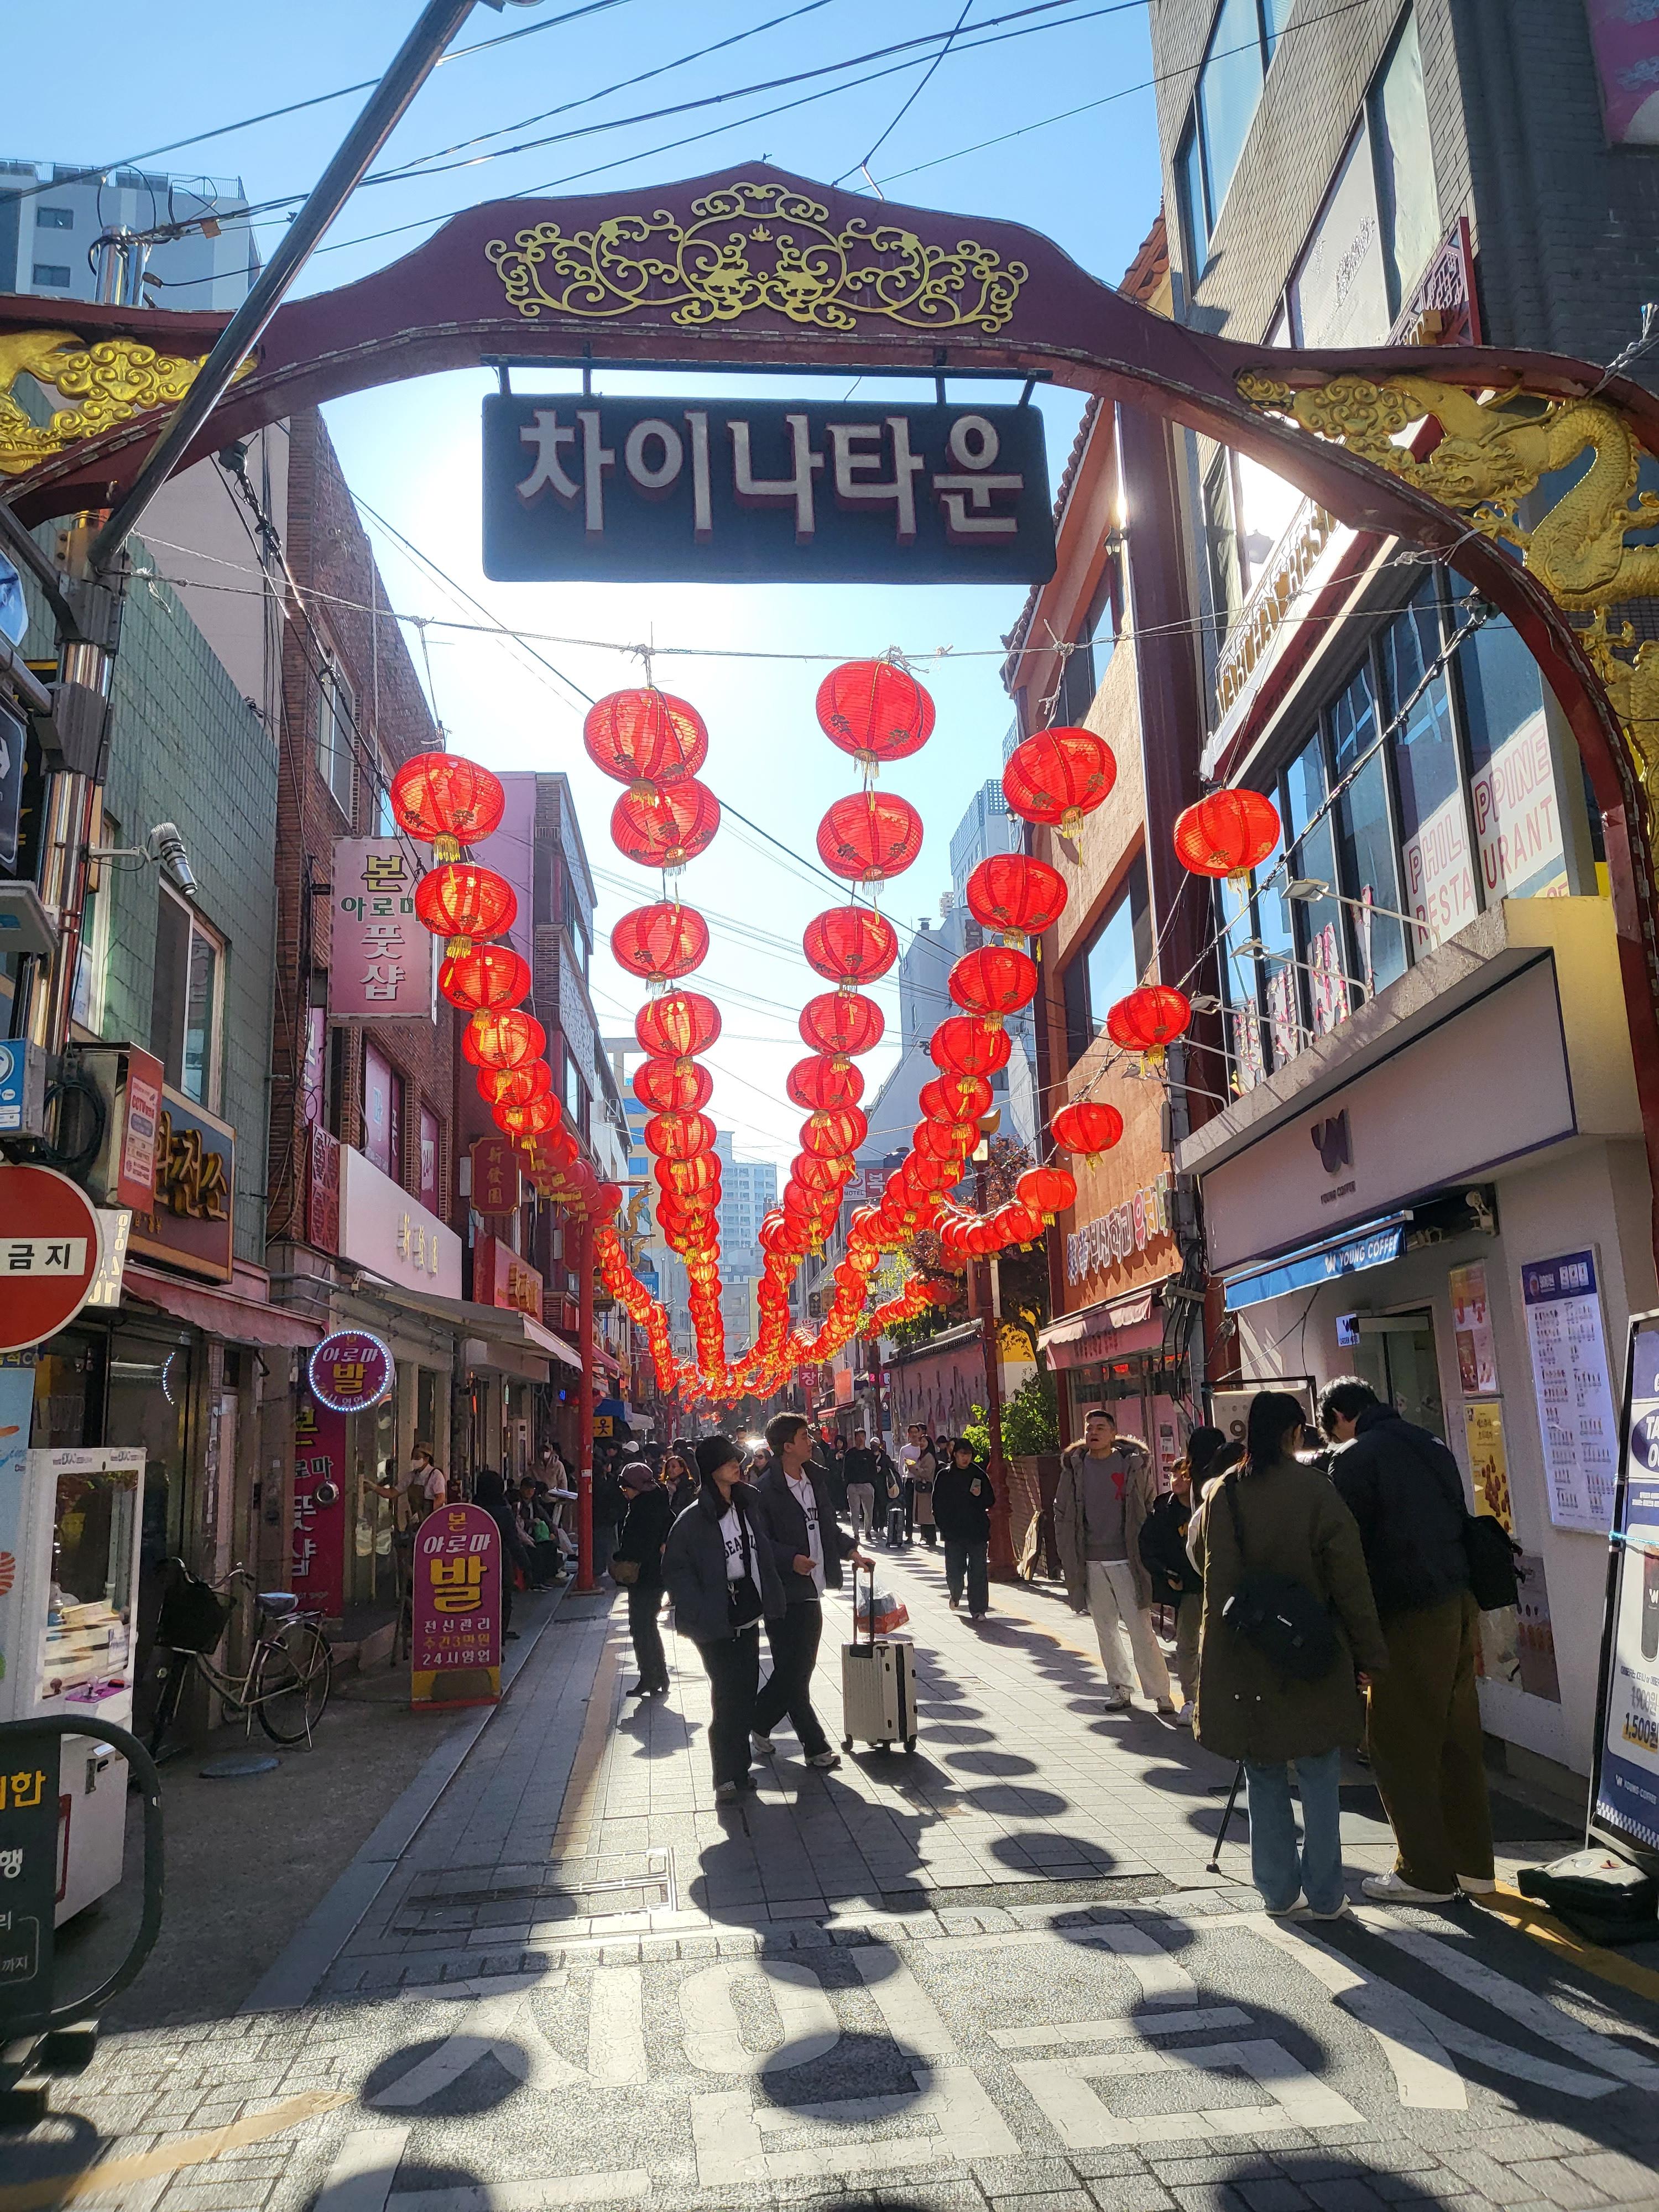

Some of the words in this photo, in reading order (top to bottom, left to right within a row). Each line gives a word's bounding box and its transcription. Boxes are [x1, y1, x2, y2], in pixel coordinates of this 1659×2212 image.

[515, 407, 1024, 546] 차이나타운
[361, 855, 408, 892] 본
[359, 924, 406, 1001] 풋샵
[8, 1243, 71, 1270] 금지
[1338, 1245, 1365, 1267] YOUNG
[322, 1347, 378, 1363] 아로마
[333, 1363, 368, 1394] 발
[597, 1418, 611, 1436] 옷
[1647, 1443, 1659, 1469] O
[447, 1511, 468, 1532] 본
[423, 1533, 492, 1554] 아로마
[430, 1555, 488, 1613] 발
[1625, 1712, 1659, 1749] 1,500원
[3, 1954, 28, 1972] 까지
